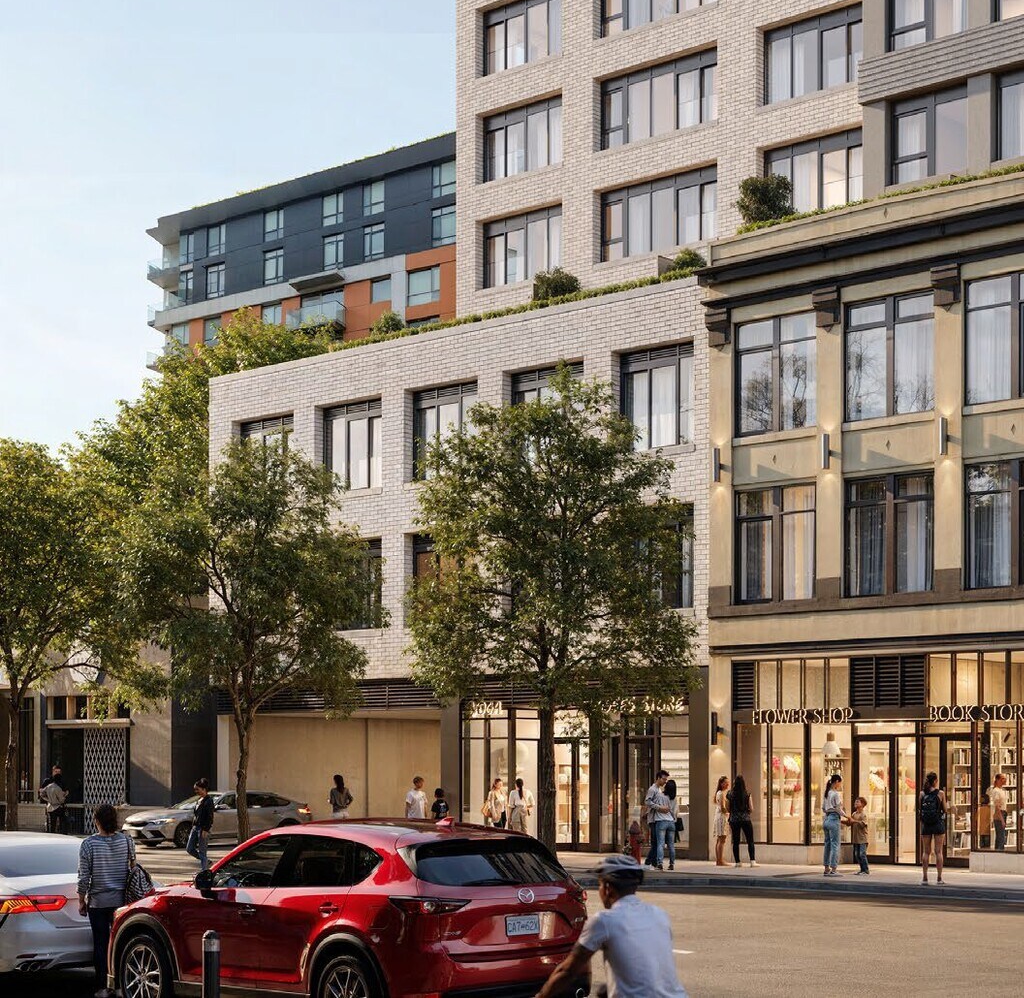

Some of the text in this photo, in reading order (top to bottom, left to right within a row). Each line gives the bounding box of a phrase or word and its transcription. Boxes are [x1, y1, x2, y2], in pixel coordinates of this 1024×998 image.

[752, 706, 854, 726] FLOWER SHOP
[929, 704, 975, 723] BOOK
